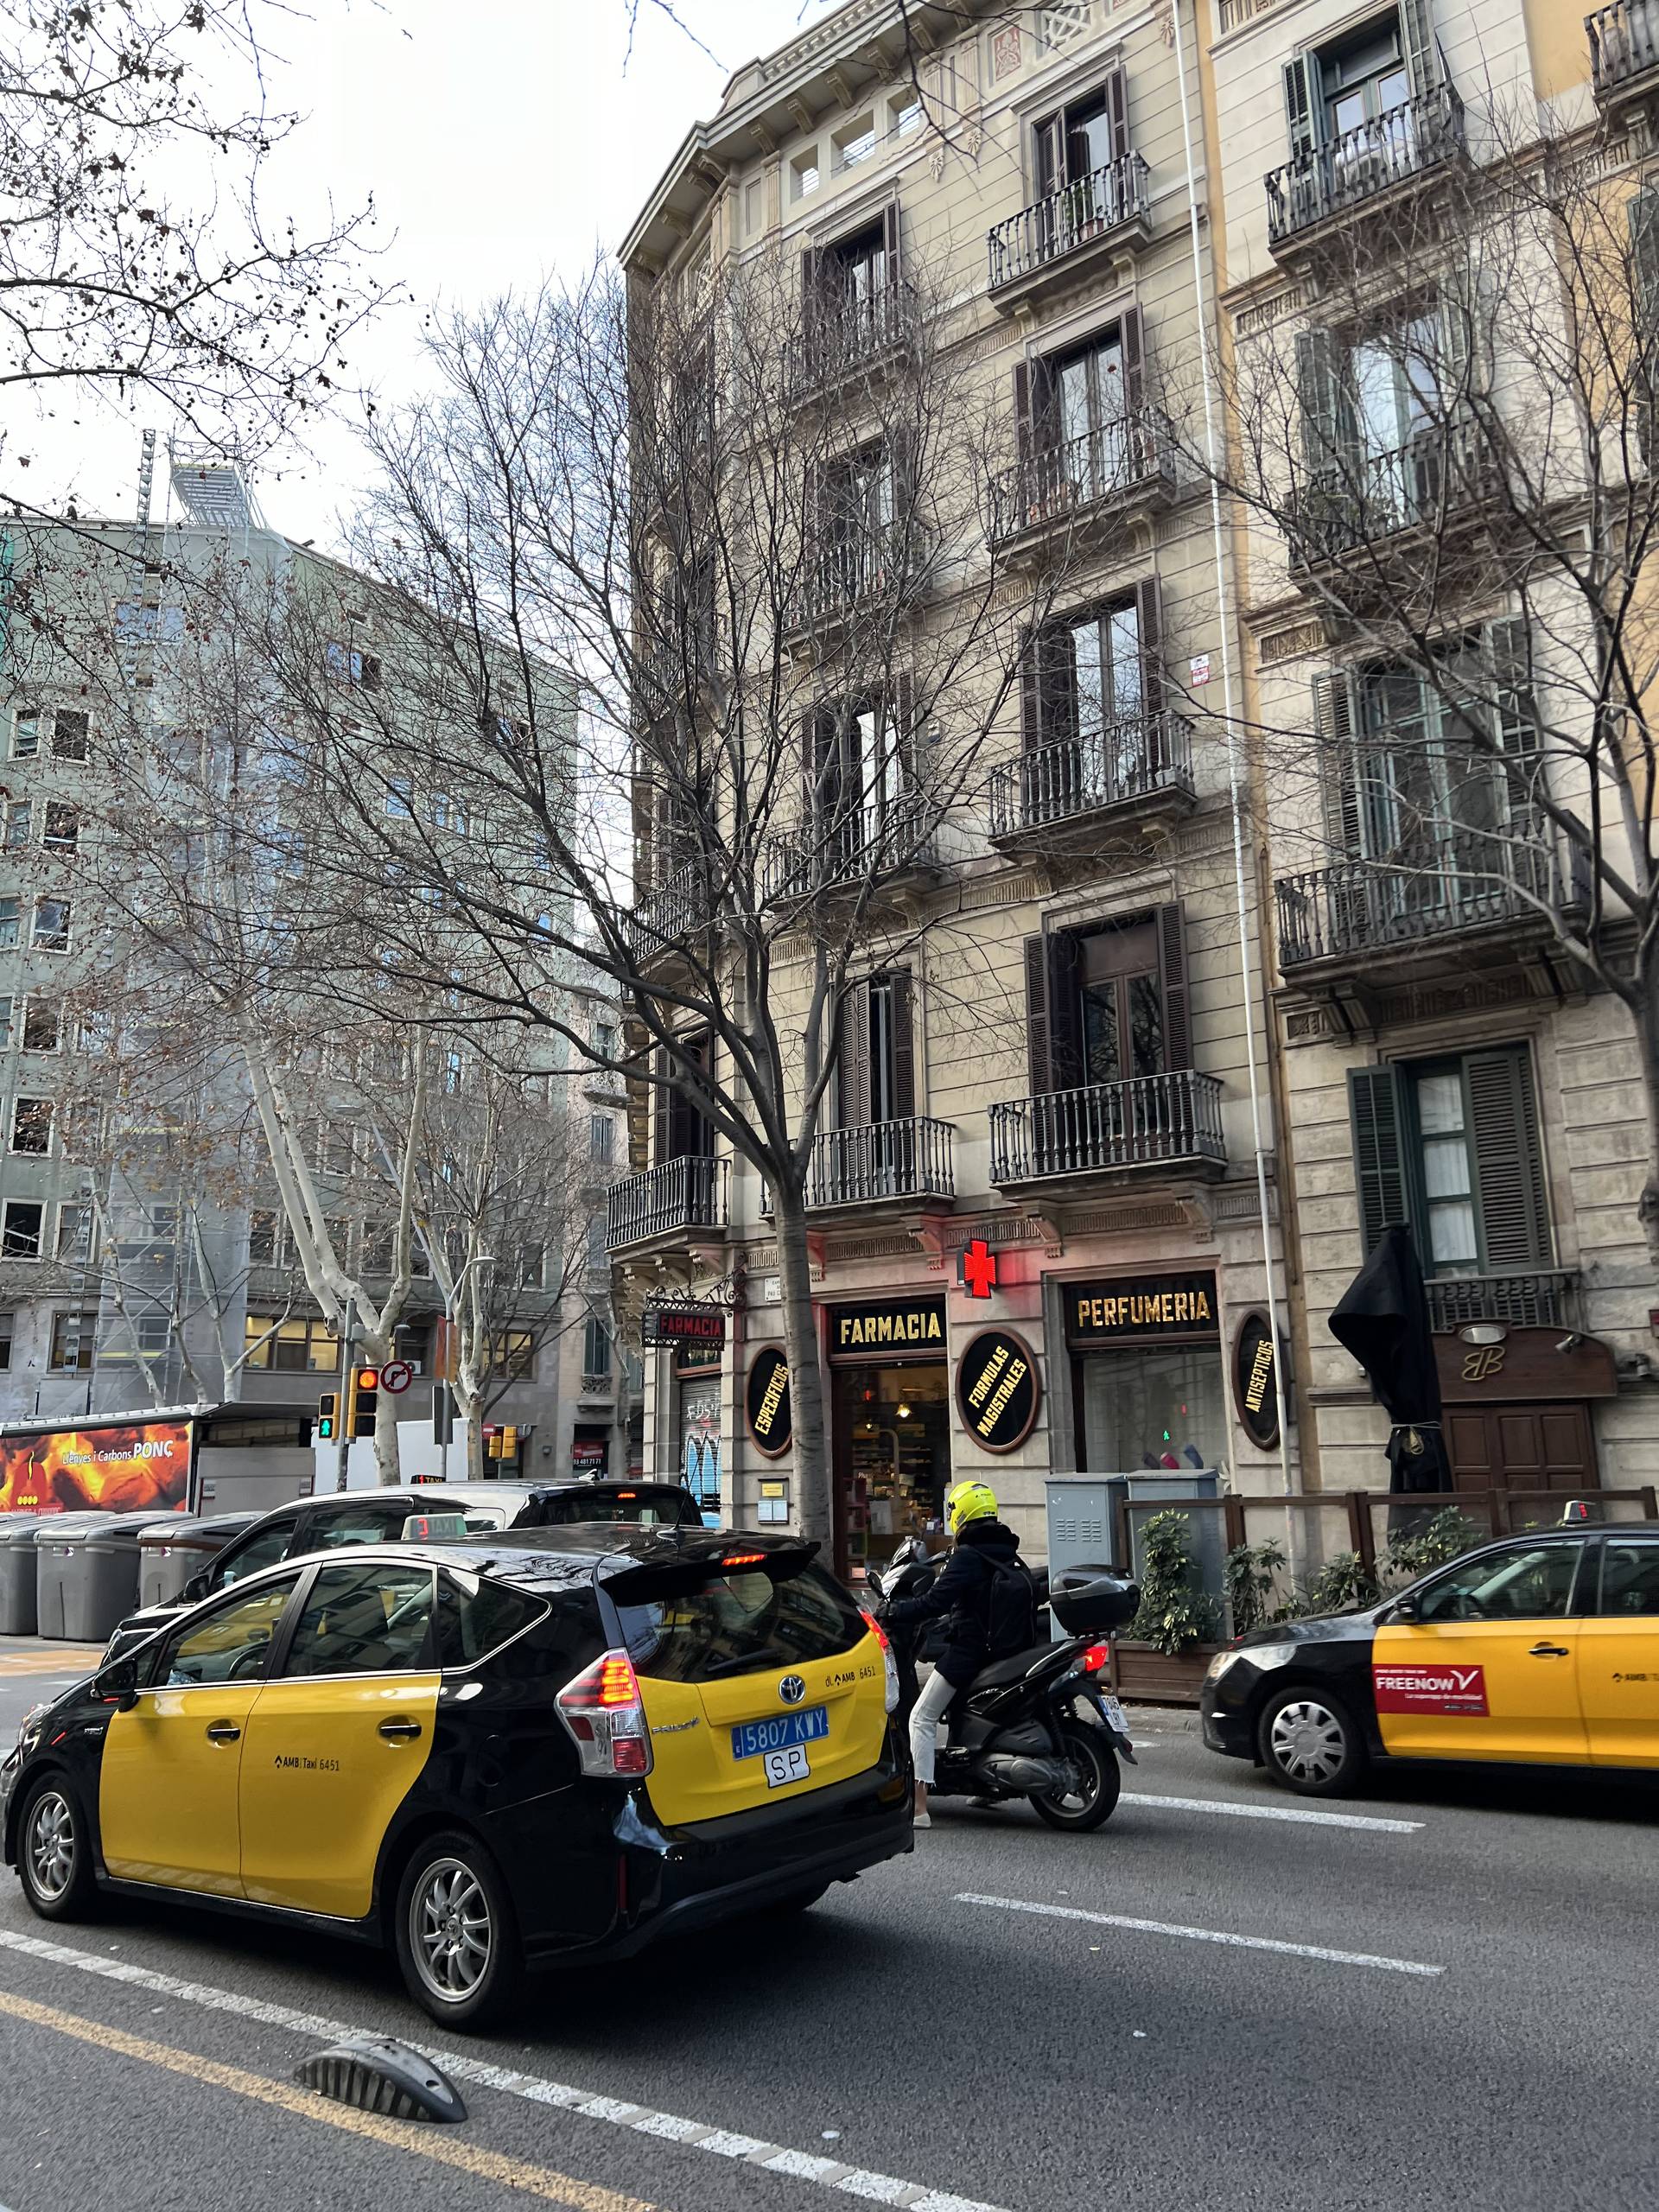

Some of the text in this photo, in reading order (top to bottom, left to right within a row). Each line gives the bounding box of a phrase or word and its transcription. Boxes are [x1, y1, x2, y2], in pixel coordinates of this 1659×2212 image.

[1078, 1292, 1211, 1327] PERFUMERIA
[660, 1313, 721, 1337] FARMACIA
[841, 1313, 941, 1344] FARMACIA
[968, 1345, 1009, 1408] FORMULAS
[1244, 1339, 1274, 1413] ANTISEPTICOS
[976, 1358, 1027, 1437] MAGISTRALES
[62, 1440, 173, 1465] Llenyes i Carbons PONÇ
[842, 1672, 855, 1683] AMB
[859, 1666, 876, 1678] 6451
[1376, 1677, 1455, 1691] FREENOW
[747, 1719, 788, 1751] 5807
[794, 1709, 823, 1740] KWY
[283, 1757, 340, 1771] AMB Taxi 6451
[771, 1751, 801, 1780] SP
